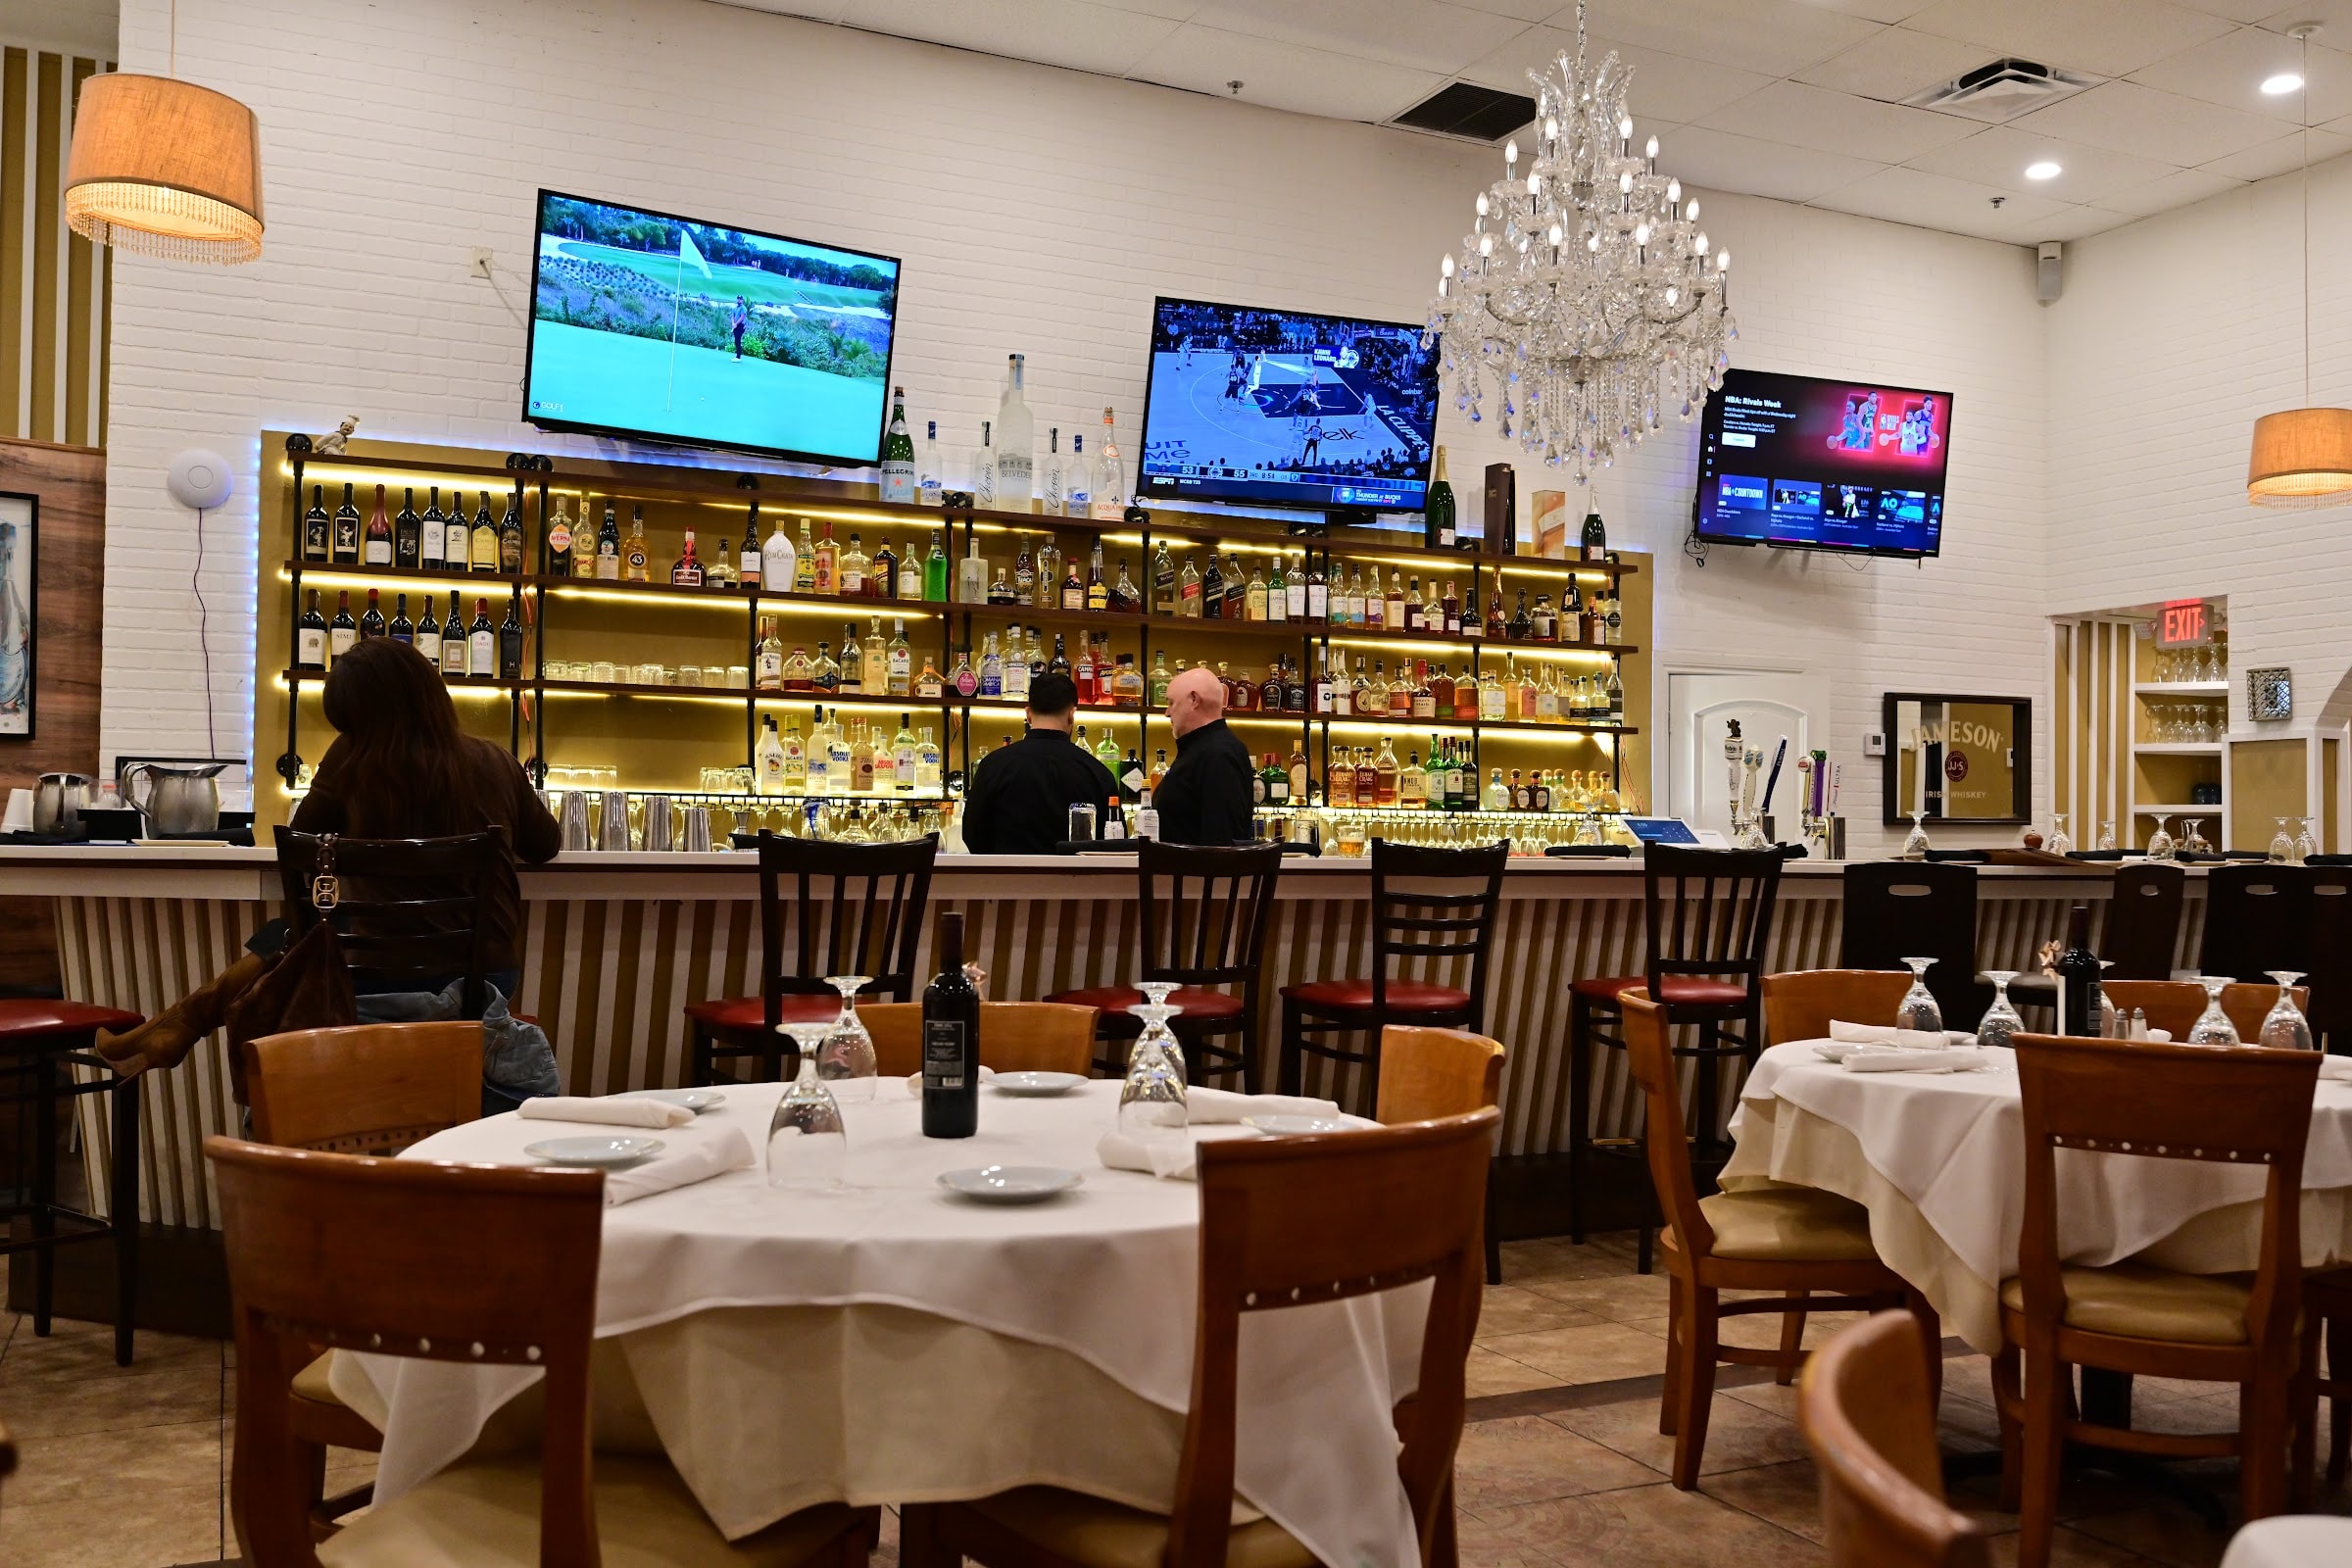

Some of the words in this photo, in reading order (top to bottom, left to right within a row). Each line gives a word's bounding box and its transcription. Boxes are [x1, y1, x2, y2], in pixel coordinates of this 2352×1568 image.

[1152, 476, 1175, 485] ESPN
[1182, 466, 1194, 474] 53
[1234, 469, 1246, 478] 55
[2164, 607, 2202, 643] EXIT
[1908, 720, 2001, 754] JAMESON
